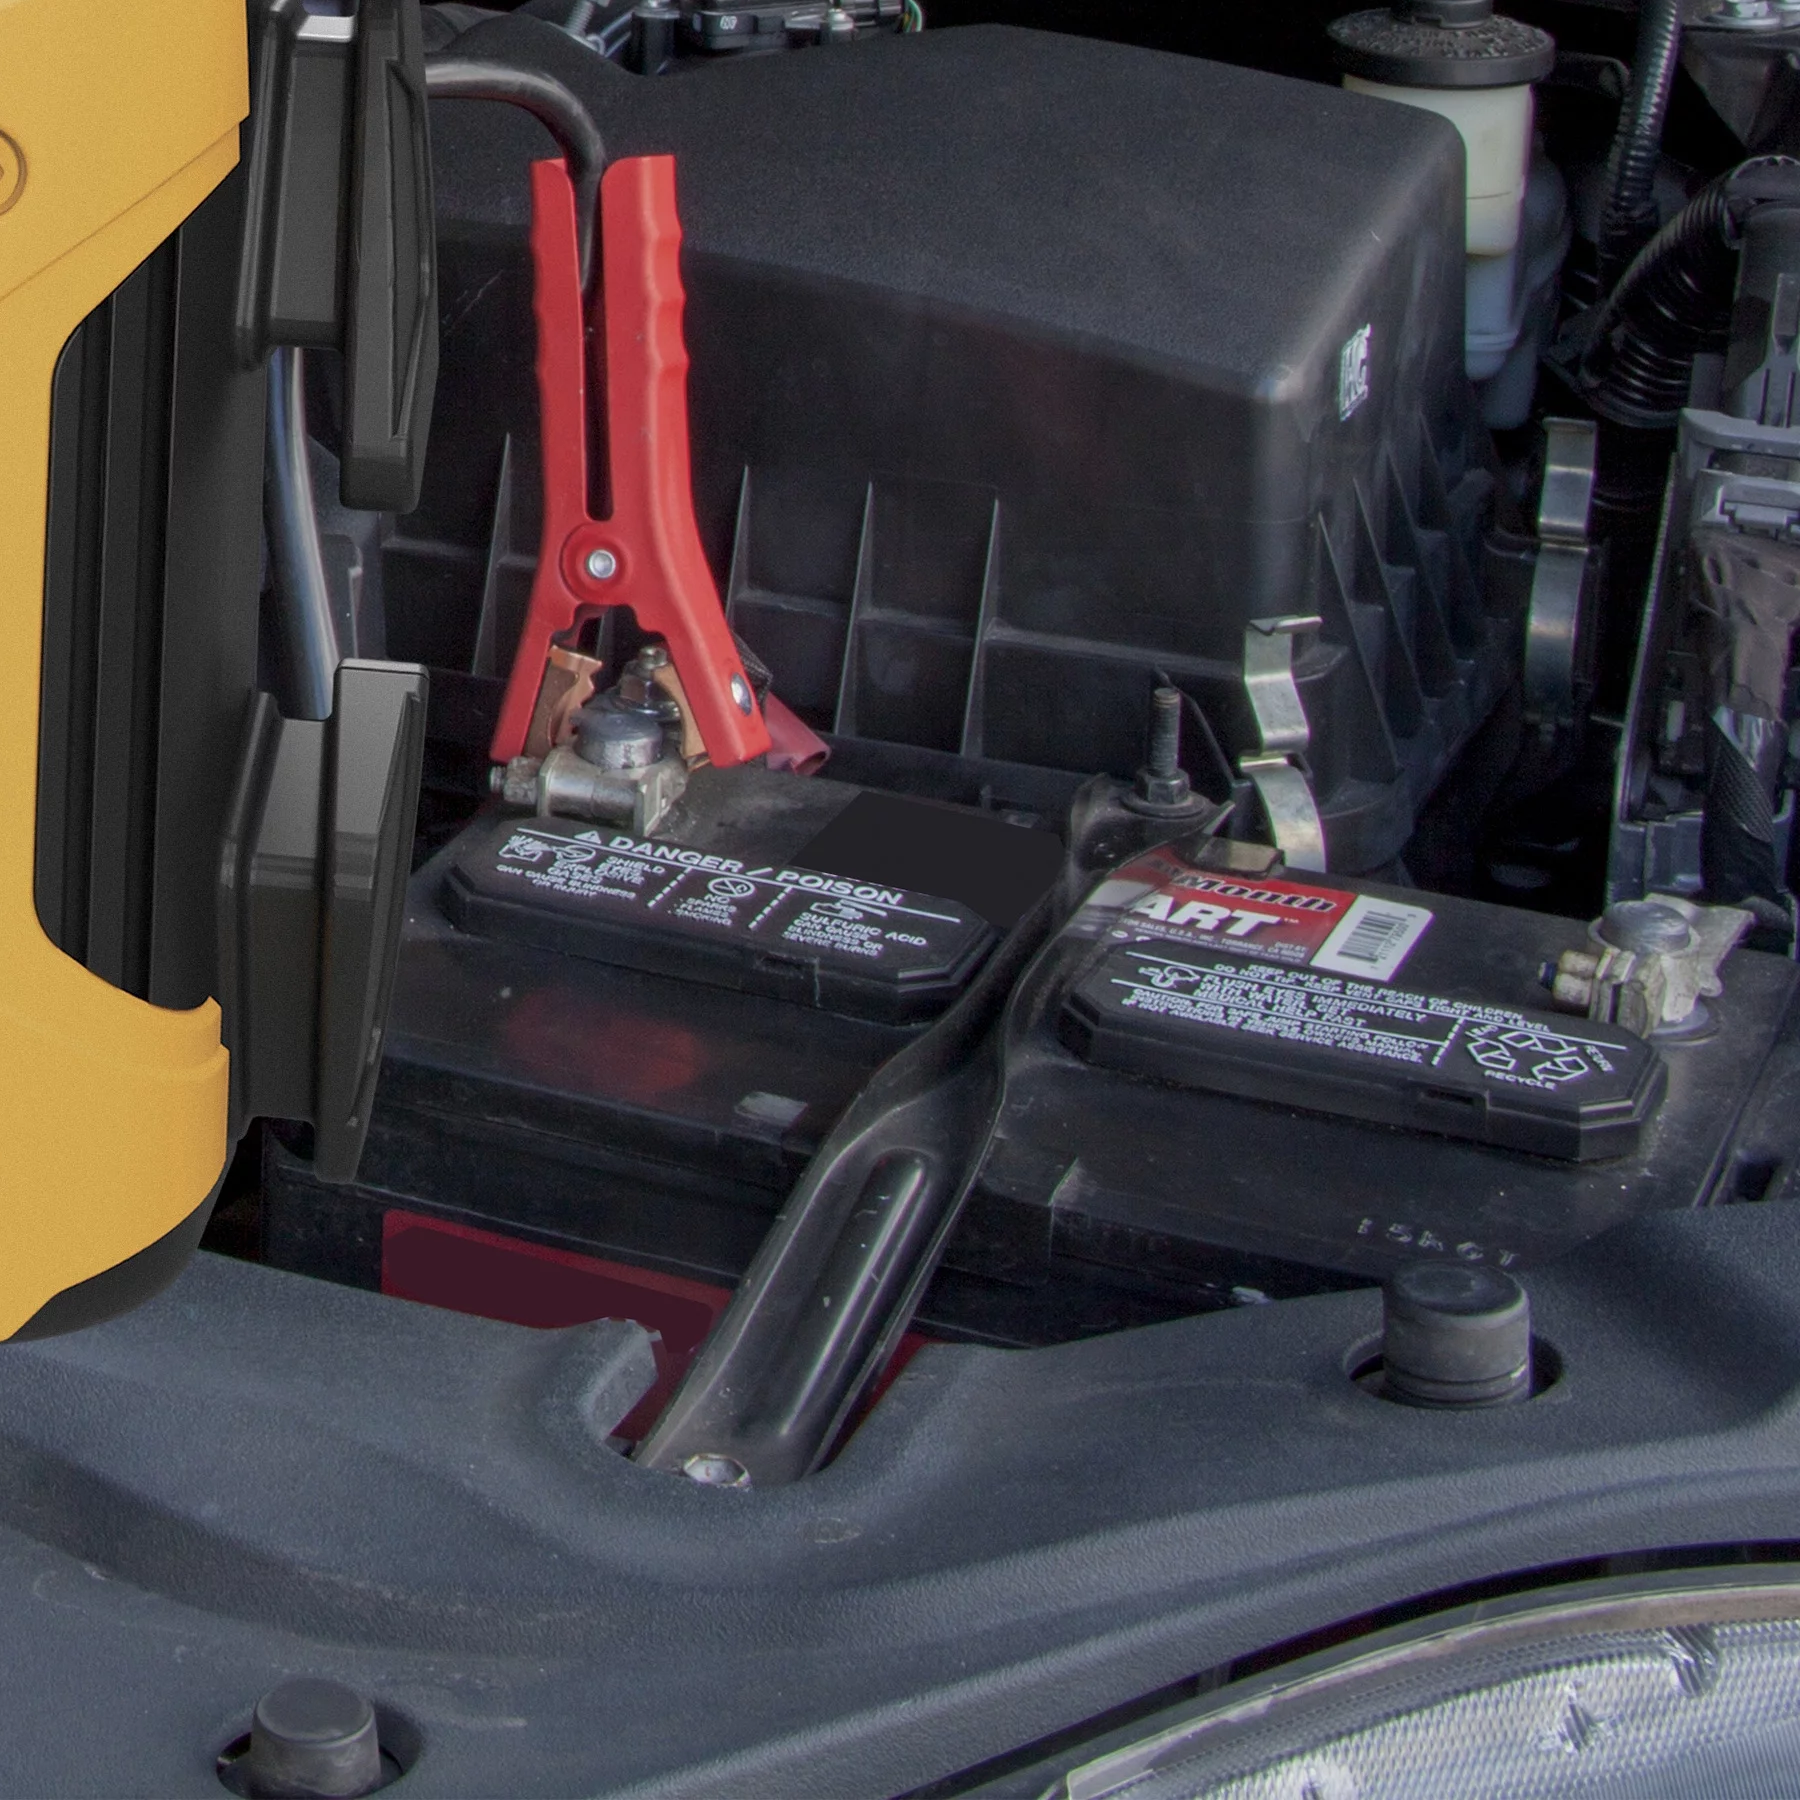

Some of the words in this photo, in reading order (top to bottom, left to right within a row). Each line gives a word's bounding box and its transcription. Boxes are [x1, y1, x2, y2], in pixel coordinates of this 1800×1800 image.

[609, 836, 743, 873] DANGER
[776, 870, 903, 905] POISON
[800, 911, 882, 936] SULFURIC
[885, 931, 927, 946] ACID
[1214, 963, 1236, 973] DO
[1239, 969, 1270, 980] NOT
[1193, 988, 1265, 1011] MEDICAL
[1272, 1003, 1318, 1018] HELP
[1321, 1013, 1368, 1028] FAST
[1202, 974, 1259, 991] FLUSH
[1311, 995, 1427, 1022] IMMEDIATELY
[1452, 1001, 1523, 1019] CHILDREN
[1484, 1069, 1557, 1090] RECYCLE
